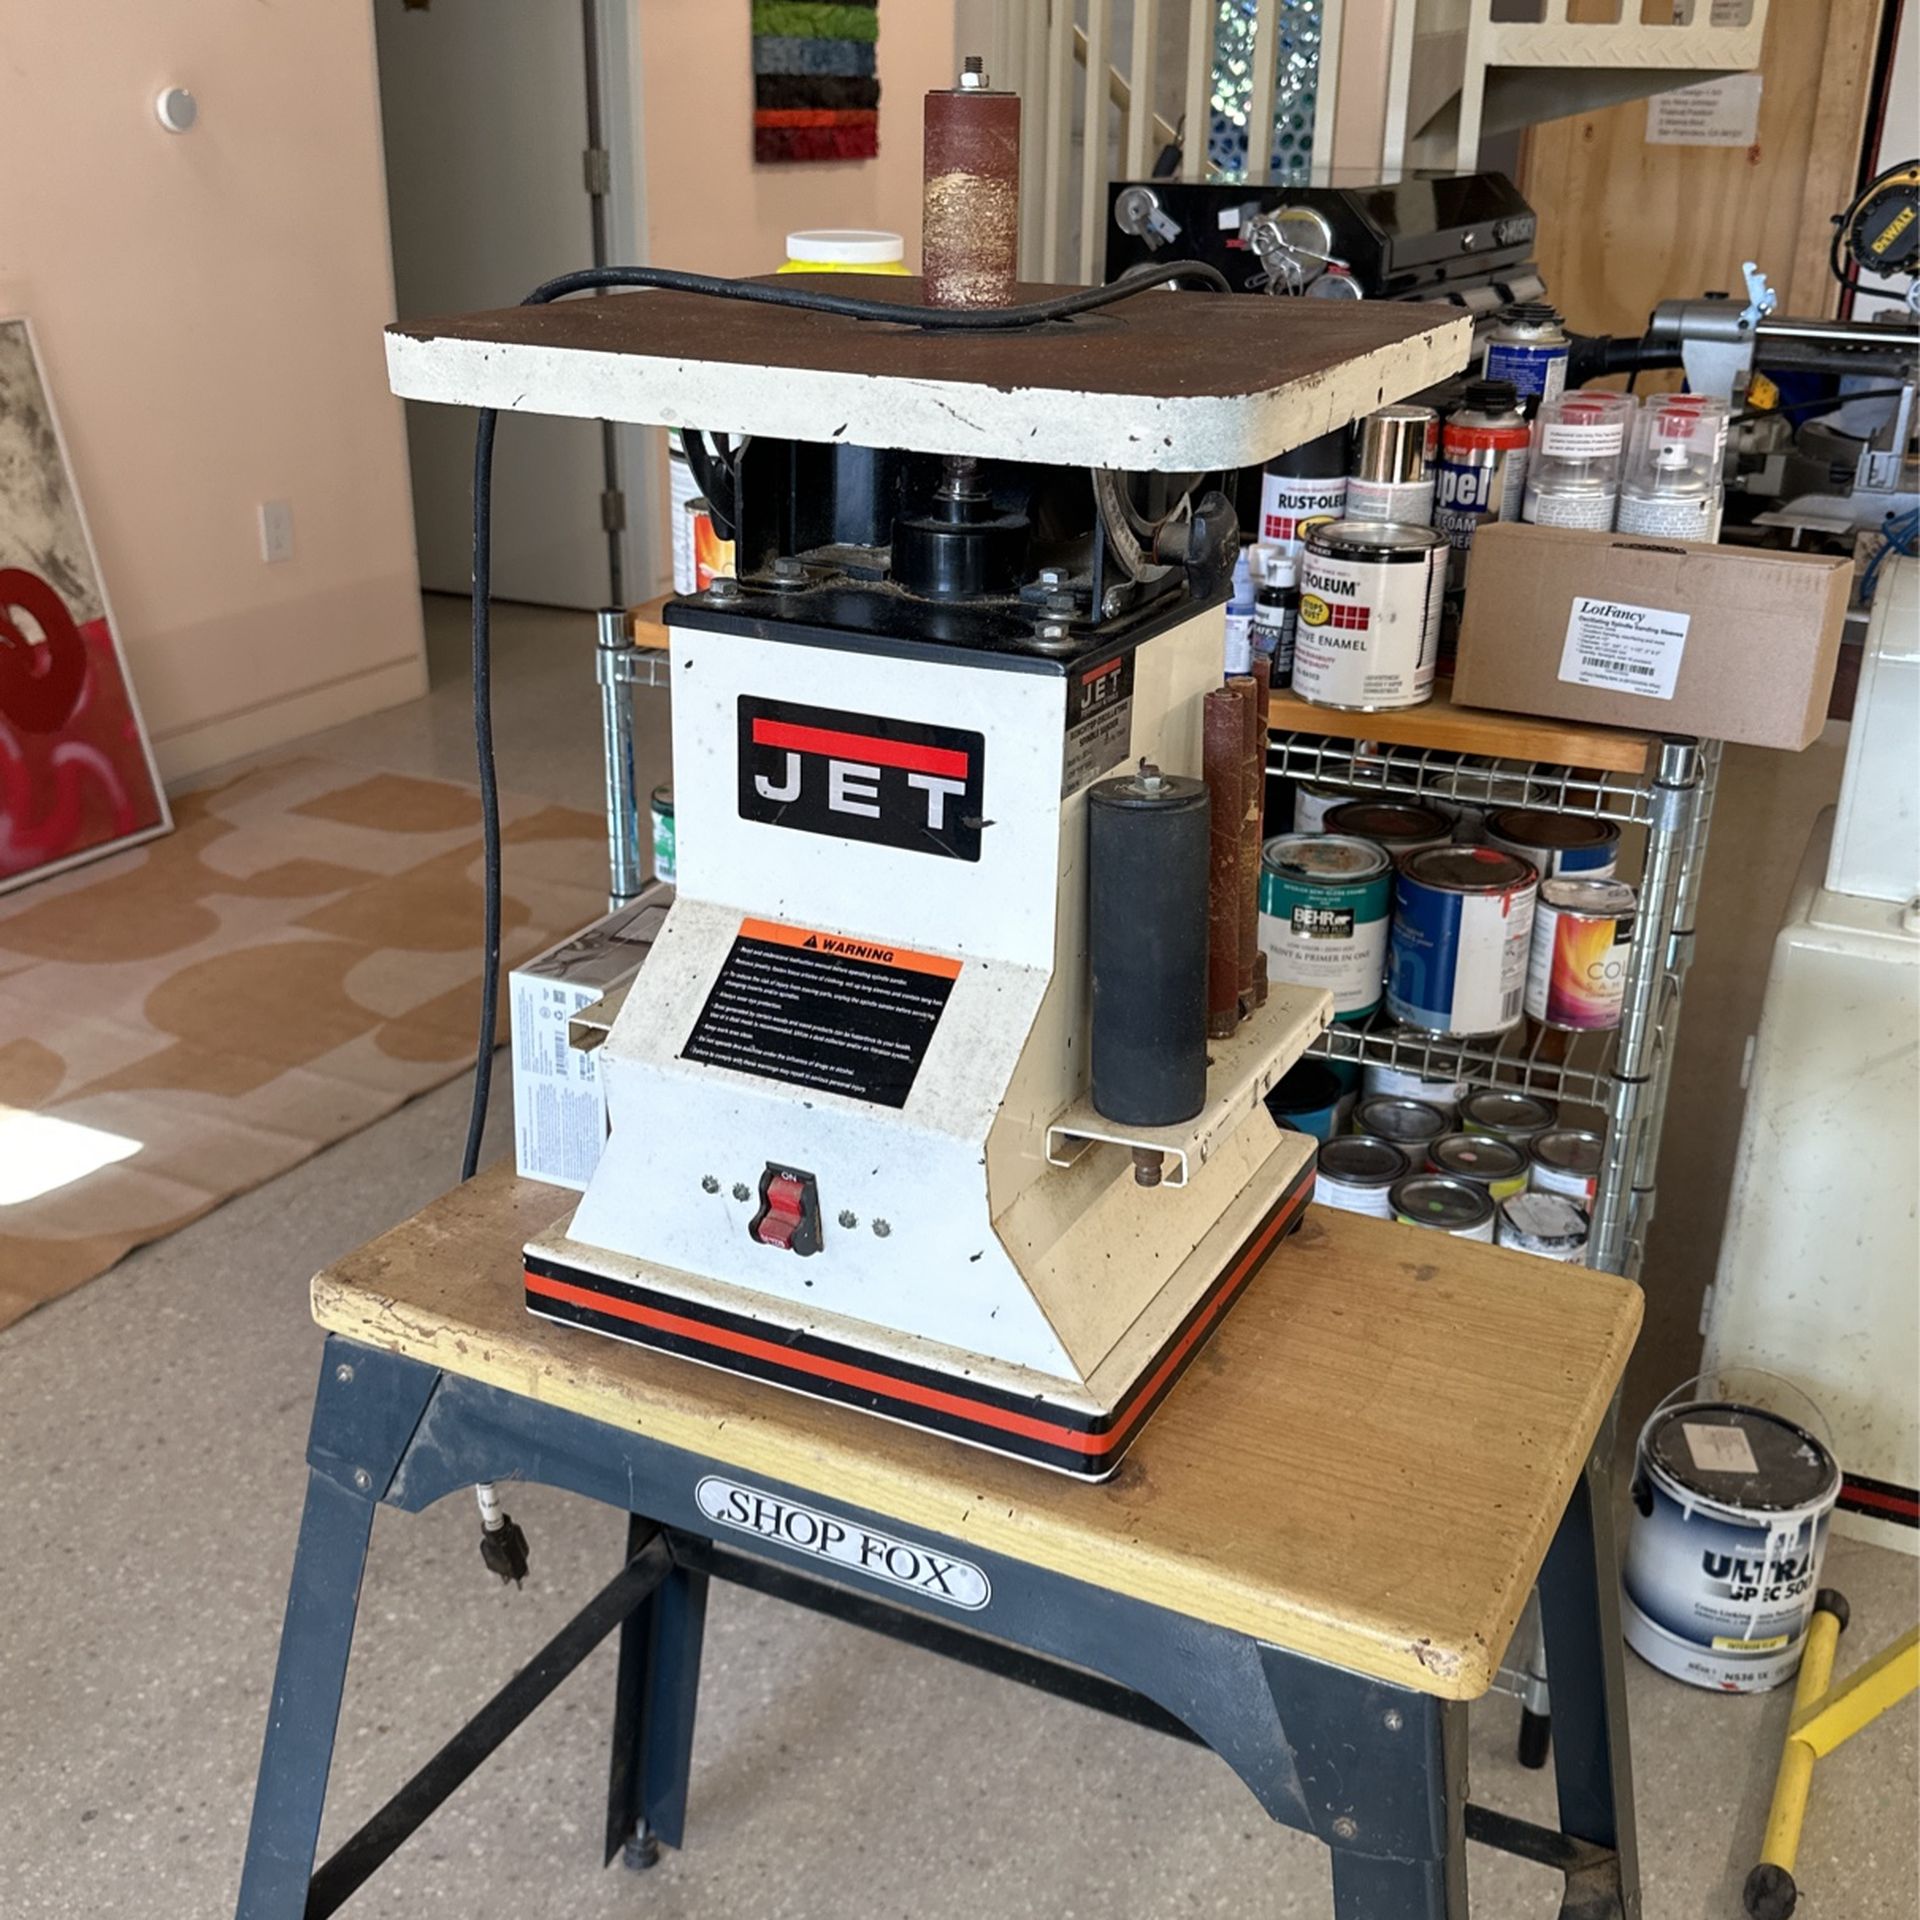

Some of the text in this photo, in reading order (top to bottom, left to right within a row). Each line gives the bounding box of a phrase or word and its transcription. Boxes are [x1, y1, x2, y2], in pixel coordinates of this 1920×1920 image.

[1871, 205, 1917, 254] DEWALT
[1277, 492, 1347, 510] RUST-OLEU
[1303, 608, 1321, 621] RUST
[1580, 601, 1646, 623] LotFancy
[1318, 634, 1367, 651] ENAMEL
[1081, 668, 1122, 709] JET
[754, 751, 967, 830] JET
[1293, 907, 1335, 926] BEHR
[822, 938, 895, 963] WARNING
[1304, 952, 1340, 962] PRIMER
[1341, 951, 1352, 961] IN
[781, 1170, 798, 1183] ON
[726, 1489, 956, 1597] SHOP FOX
[1702, 1549, 1815, 1585] ULTRA
